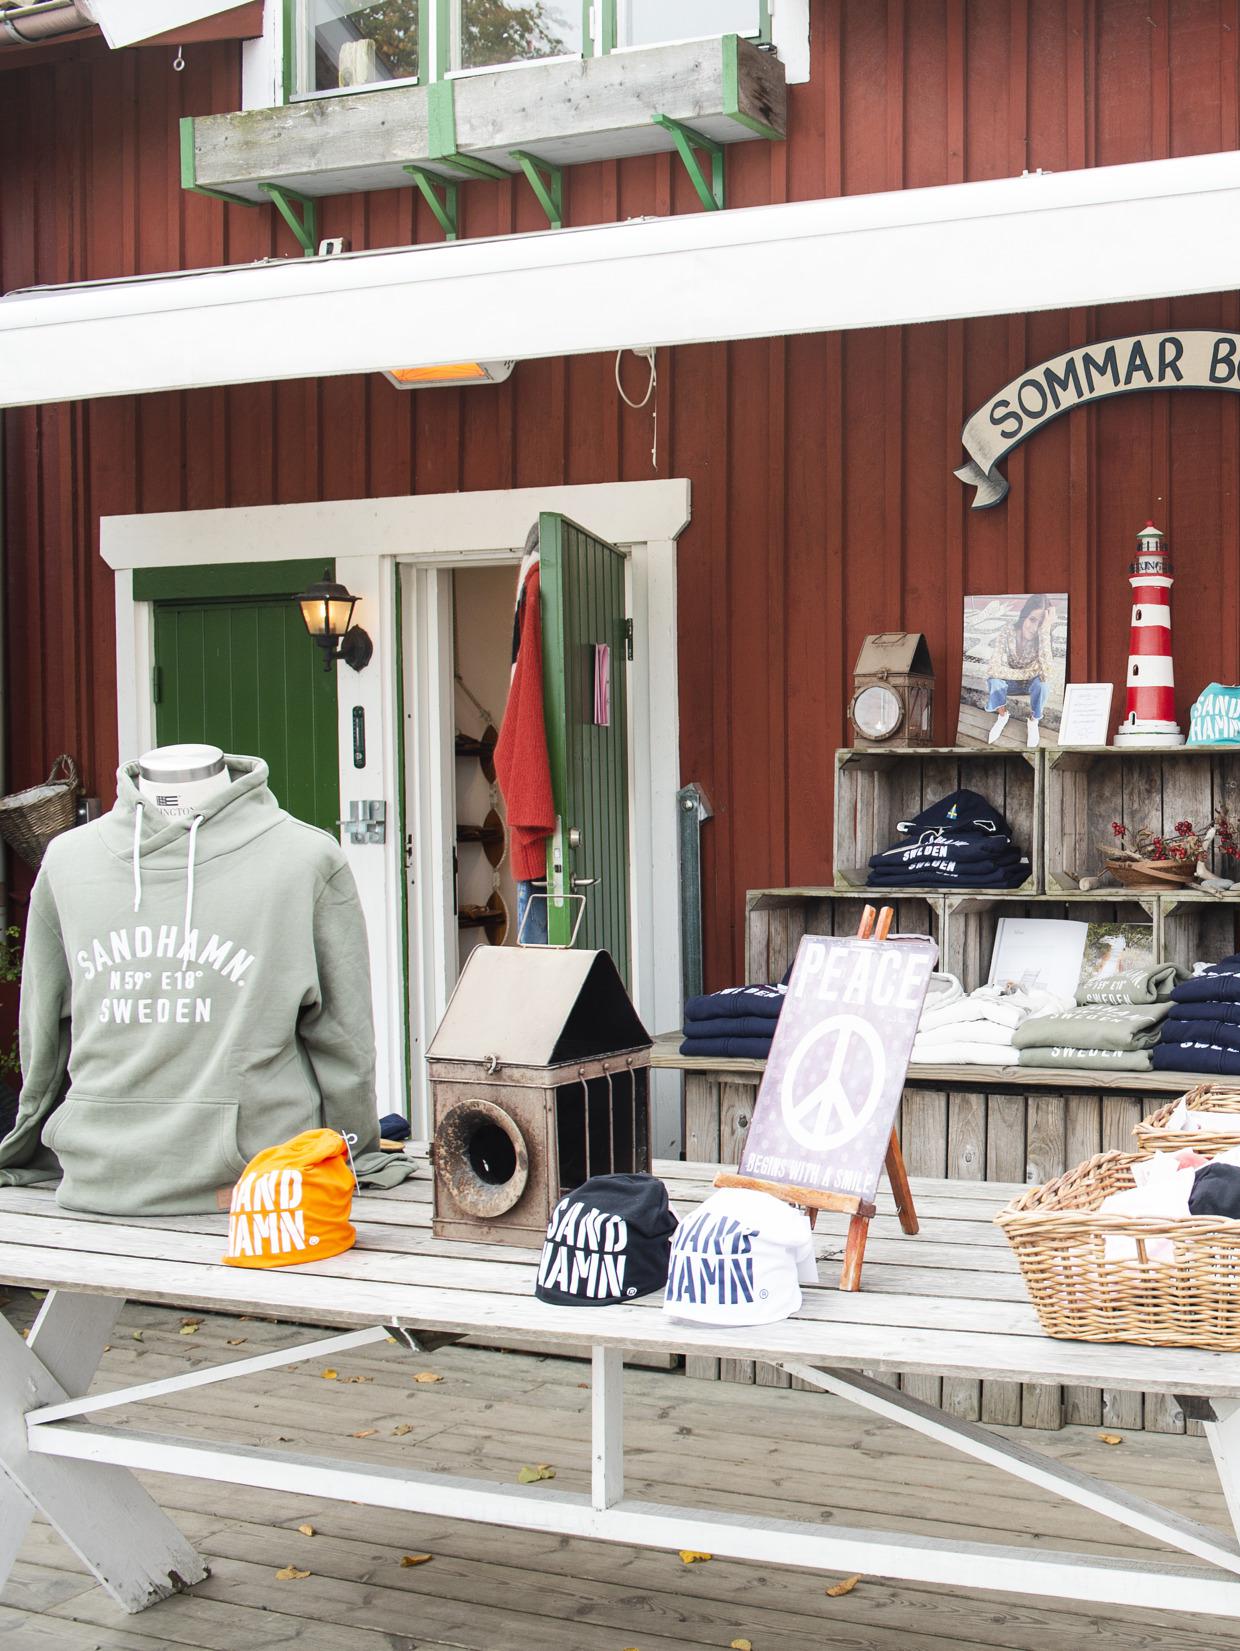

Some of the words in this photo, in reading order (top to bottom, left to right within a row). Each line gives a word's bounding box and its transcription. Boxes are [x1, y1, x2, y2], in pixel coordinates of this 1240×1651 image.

[988, 336, 1185, 440] SOMMAR
[794, 942, 930, 1010] PEACE
[99, 997, 212, 1025] SWEDEN
[746, 1152, 787, 1179] BEGINS
[788, 1158, 821, 1186] WITH
[821, 1165, 834, 1188] A
[833, 1168, 874, 1193] SMILE
